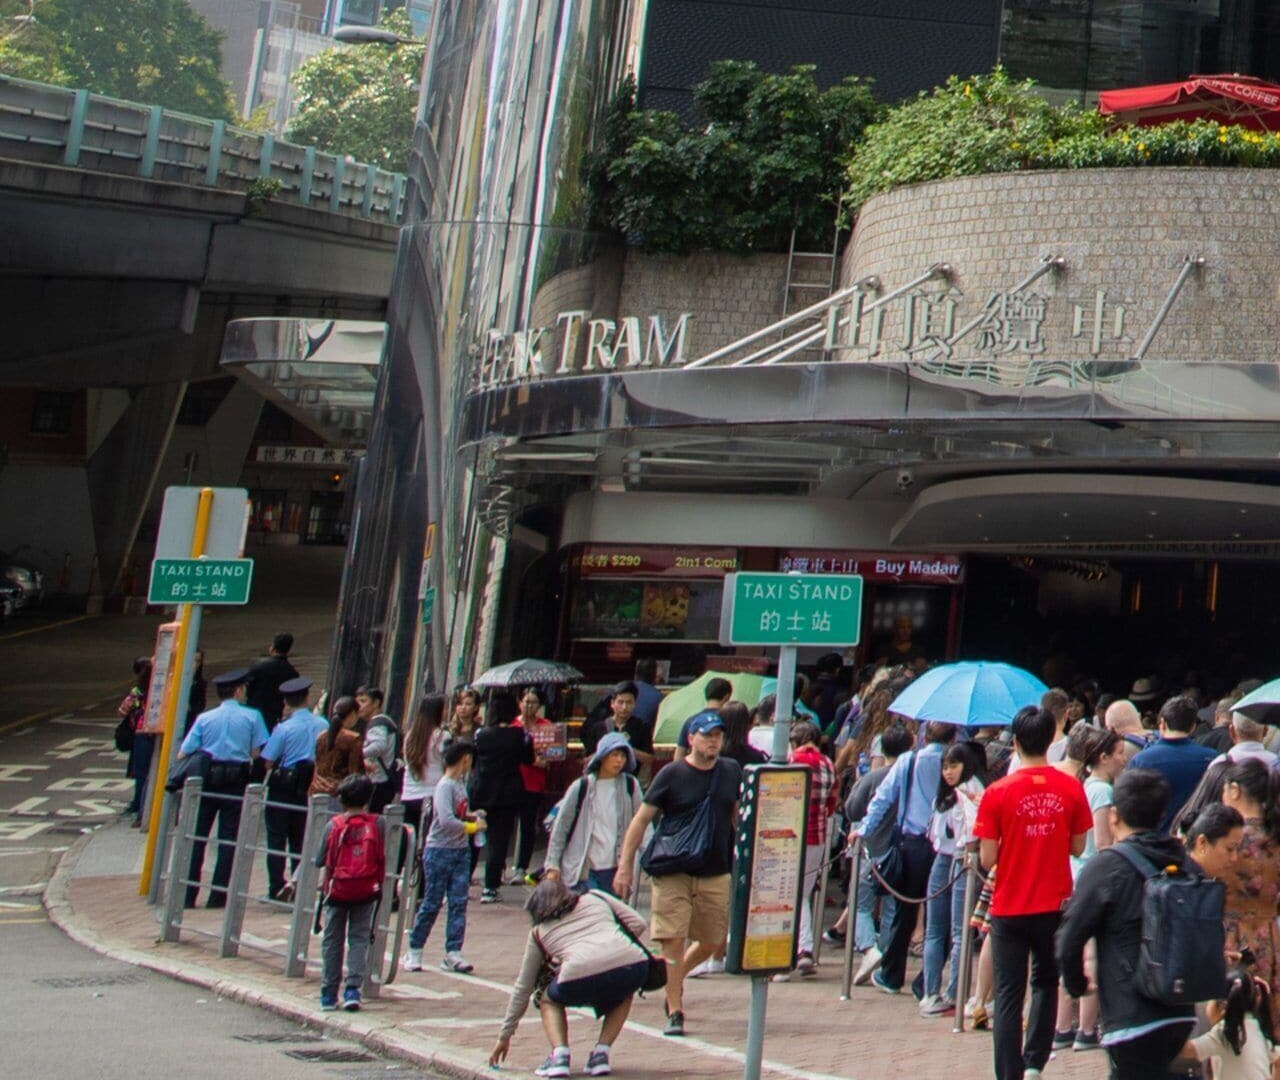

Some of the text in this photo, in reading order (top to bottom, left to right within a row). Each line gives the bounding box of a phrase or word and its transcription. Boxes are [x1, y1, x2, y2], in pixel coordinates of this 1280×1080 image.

[1234, 84, 1280, 105] COFFEE
[824, 286, 1136, 361] 山頂纜車
[556, 310, 694, 374] TRAM
[612, 555, 641, 567] $290
[675, 556, 700, 567] 2in1
[875, 559, 906, 576] Buy
[160, 564, 244, 577] TAXI STAND
[171, 582, 227, 597] 的士站
[743, 583, 853, 601] TAXI STAND
[760, 609, 832, 632] 的士站
